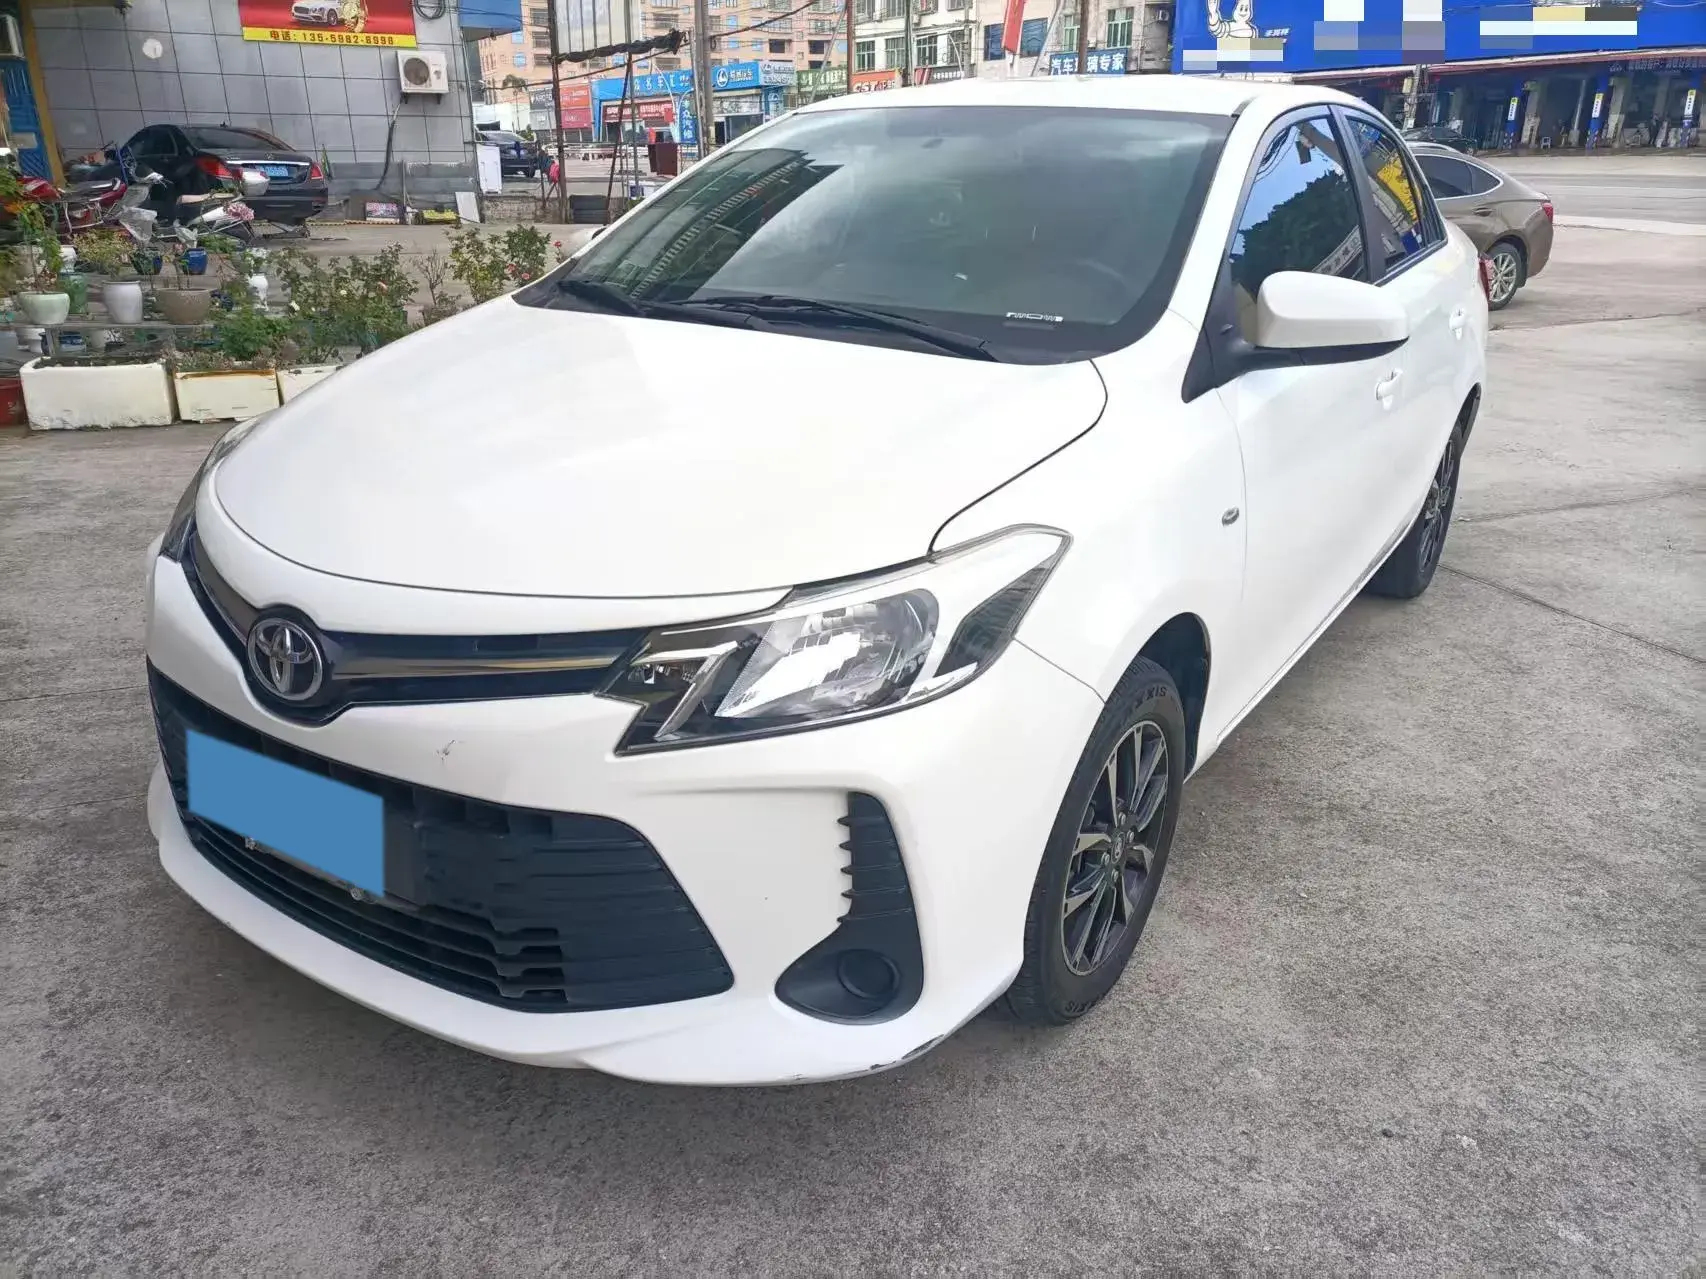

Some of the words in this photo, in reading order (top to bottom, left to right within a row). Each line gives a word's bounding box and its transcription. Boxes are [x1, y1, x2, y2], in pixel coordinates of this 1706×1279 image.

[1051, 52, 1125, 76] 汽车璃专家
